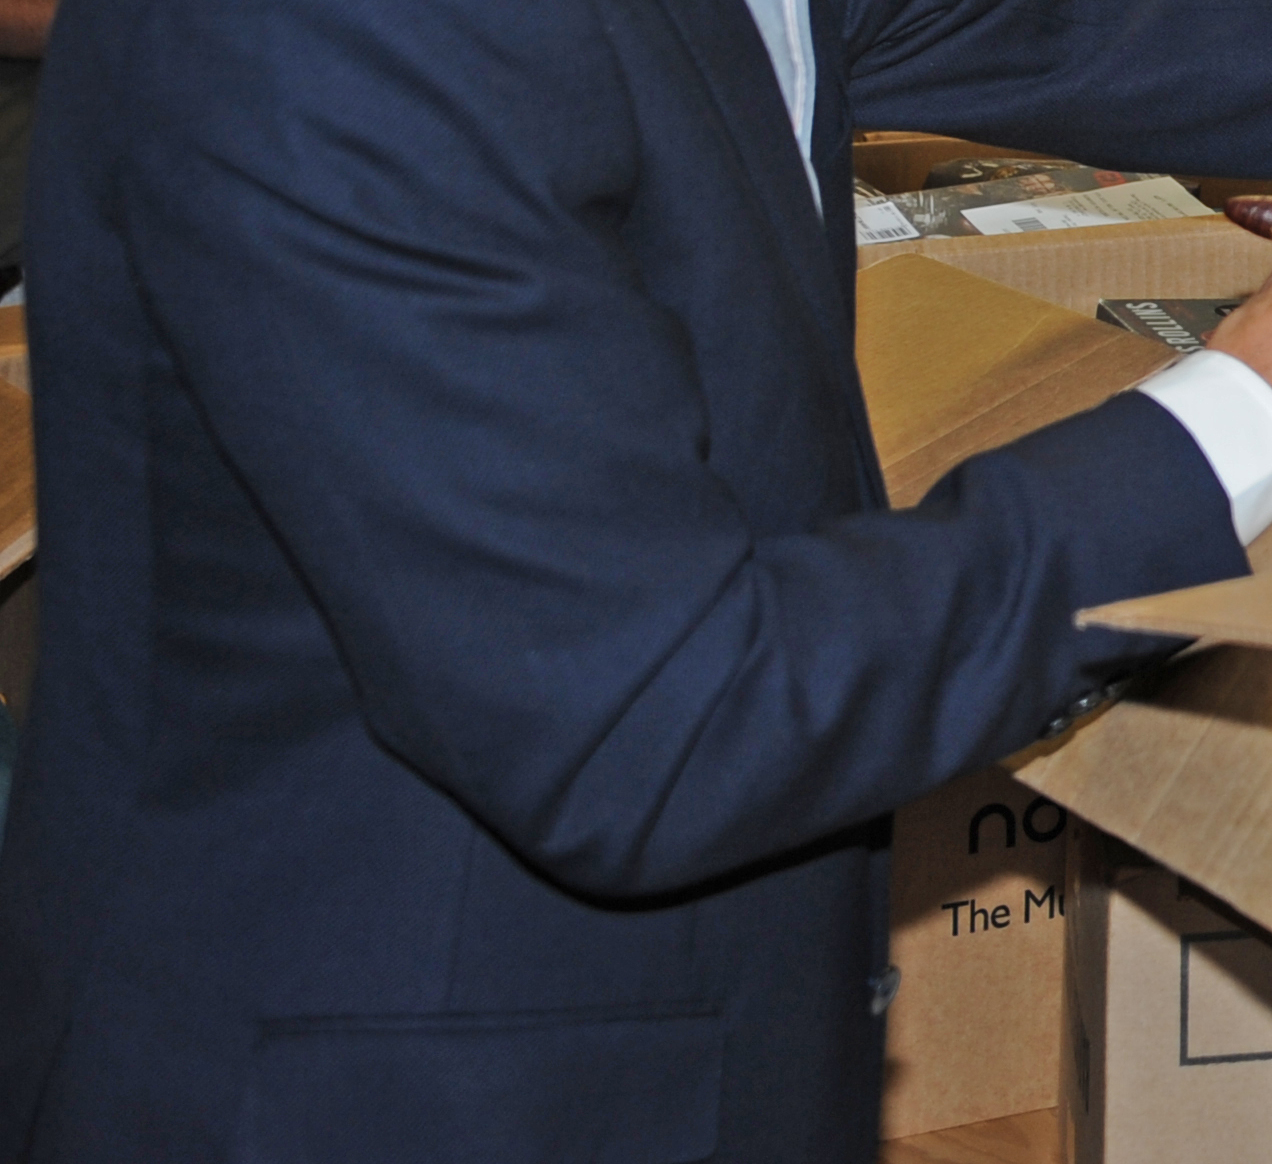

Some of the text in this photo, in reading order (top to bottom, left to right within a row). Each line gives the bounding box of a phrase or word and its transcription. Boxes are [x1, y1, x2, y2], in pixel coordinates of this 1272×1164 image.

[1125, 302, 1200, 345] ROLLINS
[968, 795, 1068, 854] no
[941, 898, 1011, 937] The
